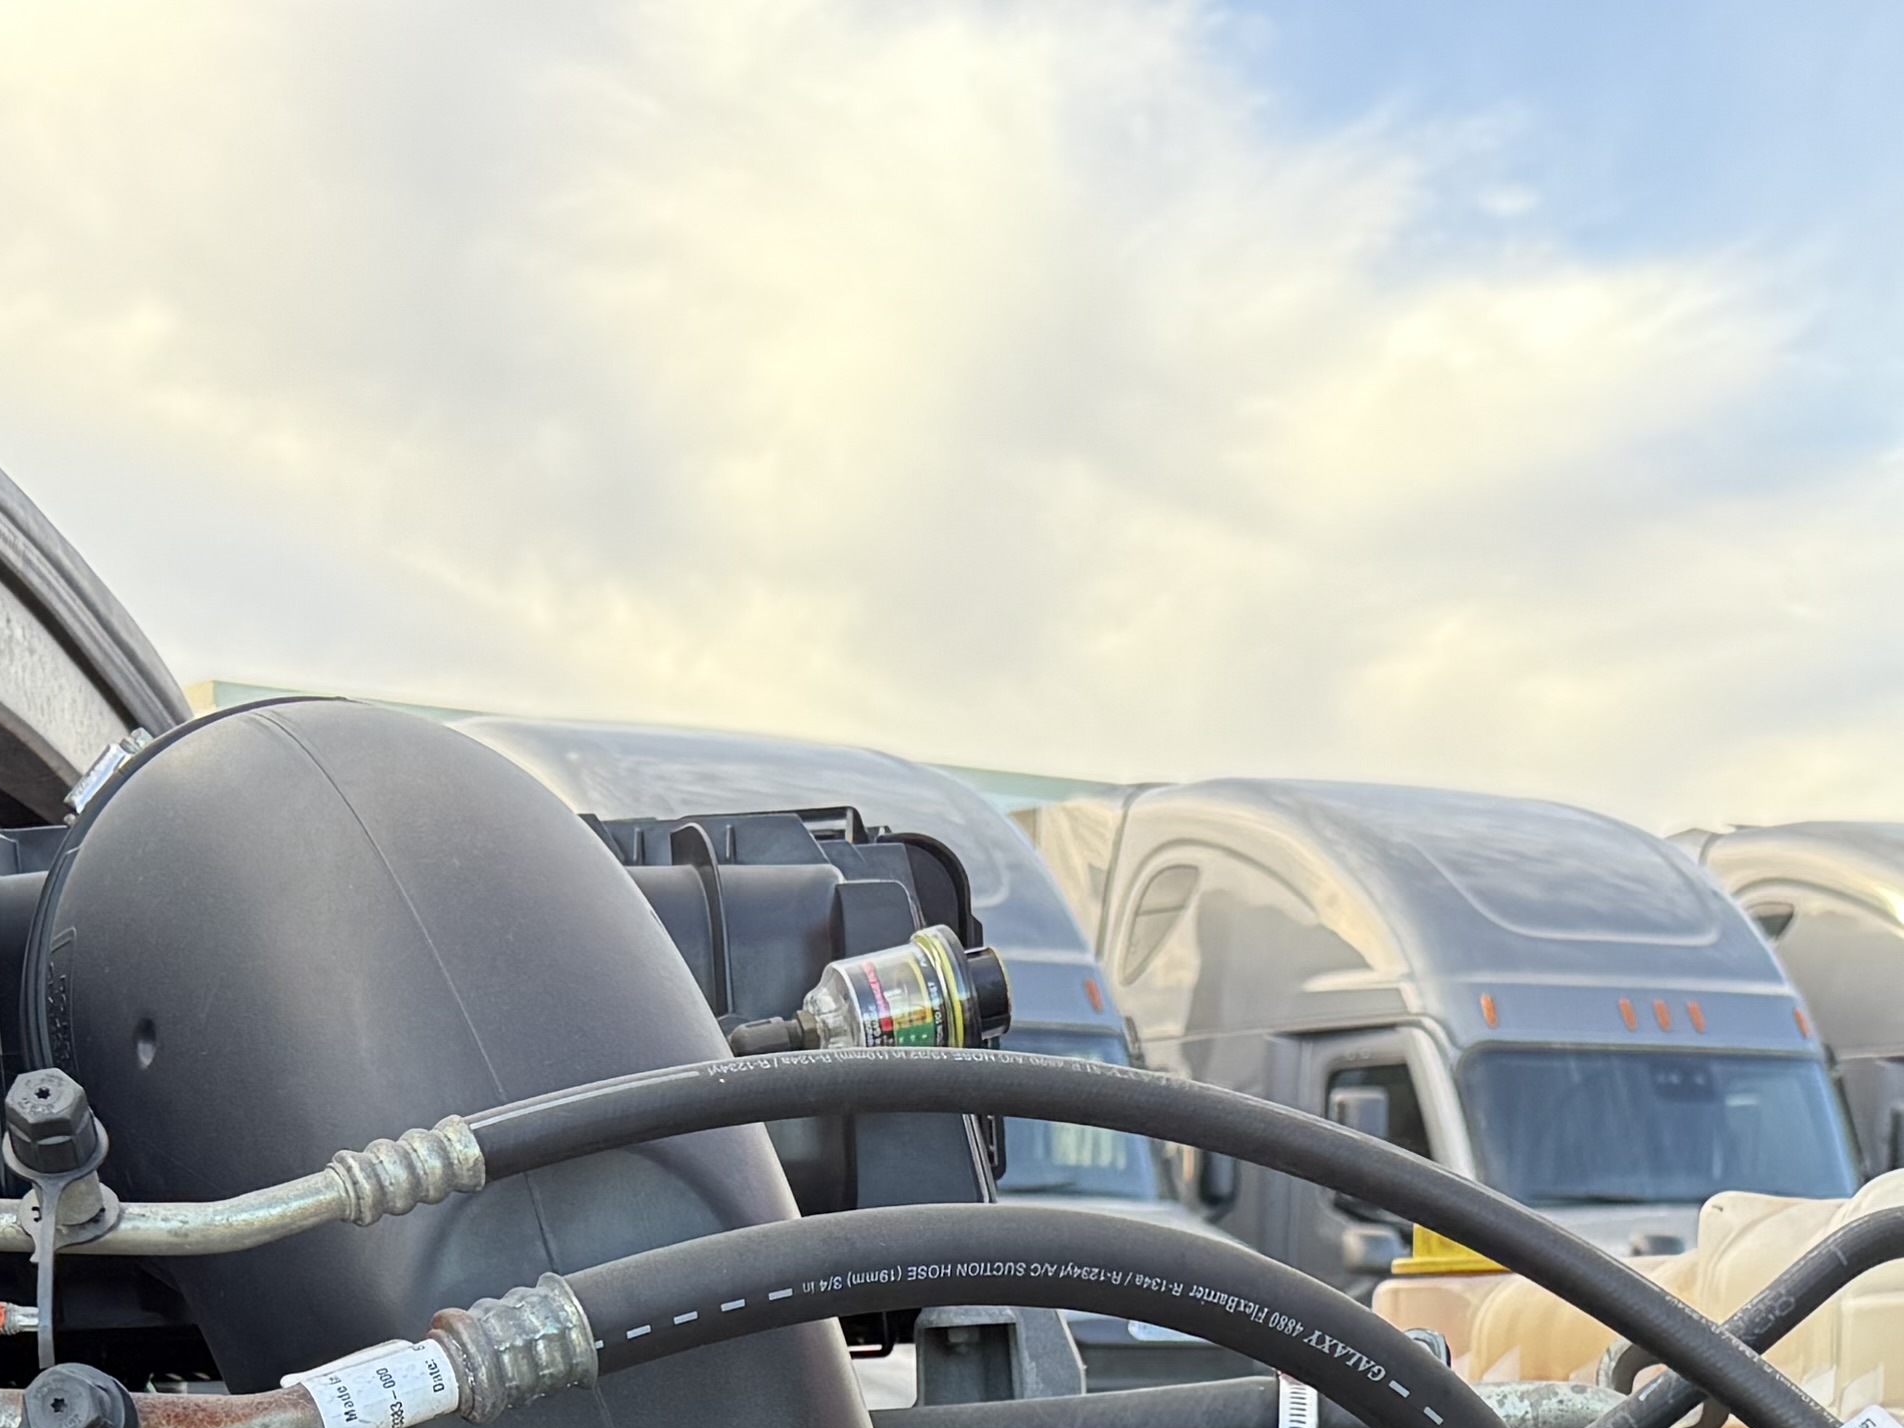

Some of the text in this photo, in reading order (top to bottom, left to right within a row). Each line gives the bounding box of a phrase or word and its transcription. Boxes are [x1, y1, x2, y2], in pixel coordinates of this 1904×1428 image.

[846, 1265, 903, 1288] (19mm)
[907, 1262, 952, 1281] HOSE
[955, 1260, 1026, 1279] SUCTION
[1030, 1261, 1060, 1278] A/C
[1066, 1262, 1123, 1285] R-1234yf
[802, 1279, 816, 1293] in
[819, 1272, 844, 1291] 3/4
[1135, 1274, 1183, 1297] R-134a
[1189, 1283, 1268, 1326] FlexBarrier
[1269, 1311, 1305, 1338] 4880
[1303, 1328, 1387, 1383] GALAXY
[425, 1358, 446, 1393] Date:
[335, 1387, 359, 1423] Made
